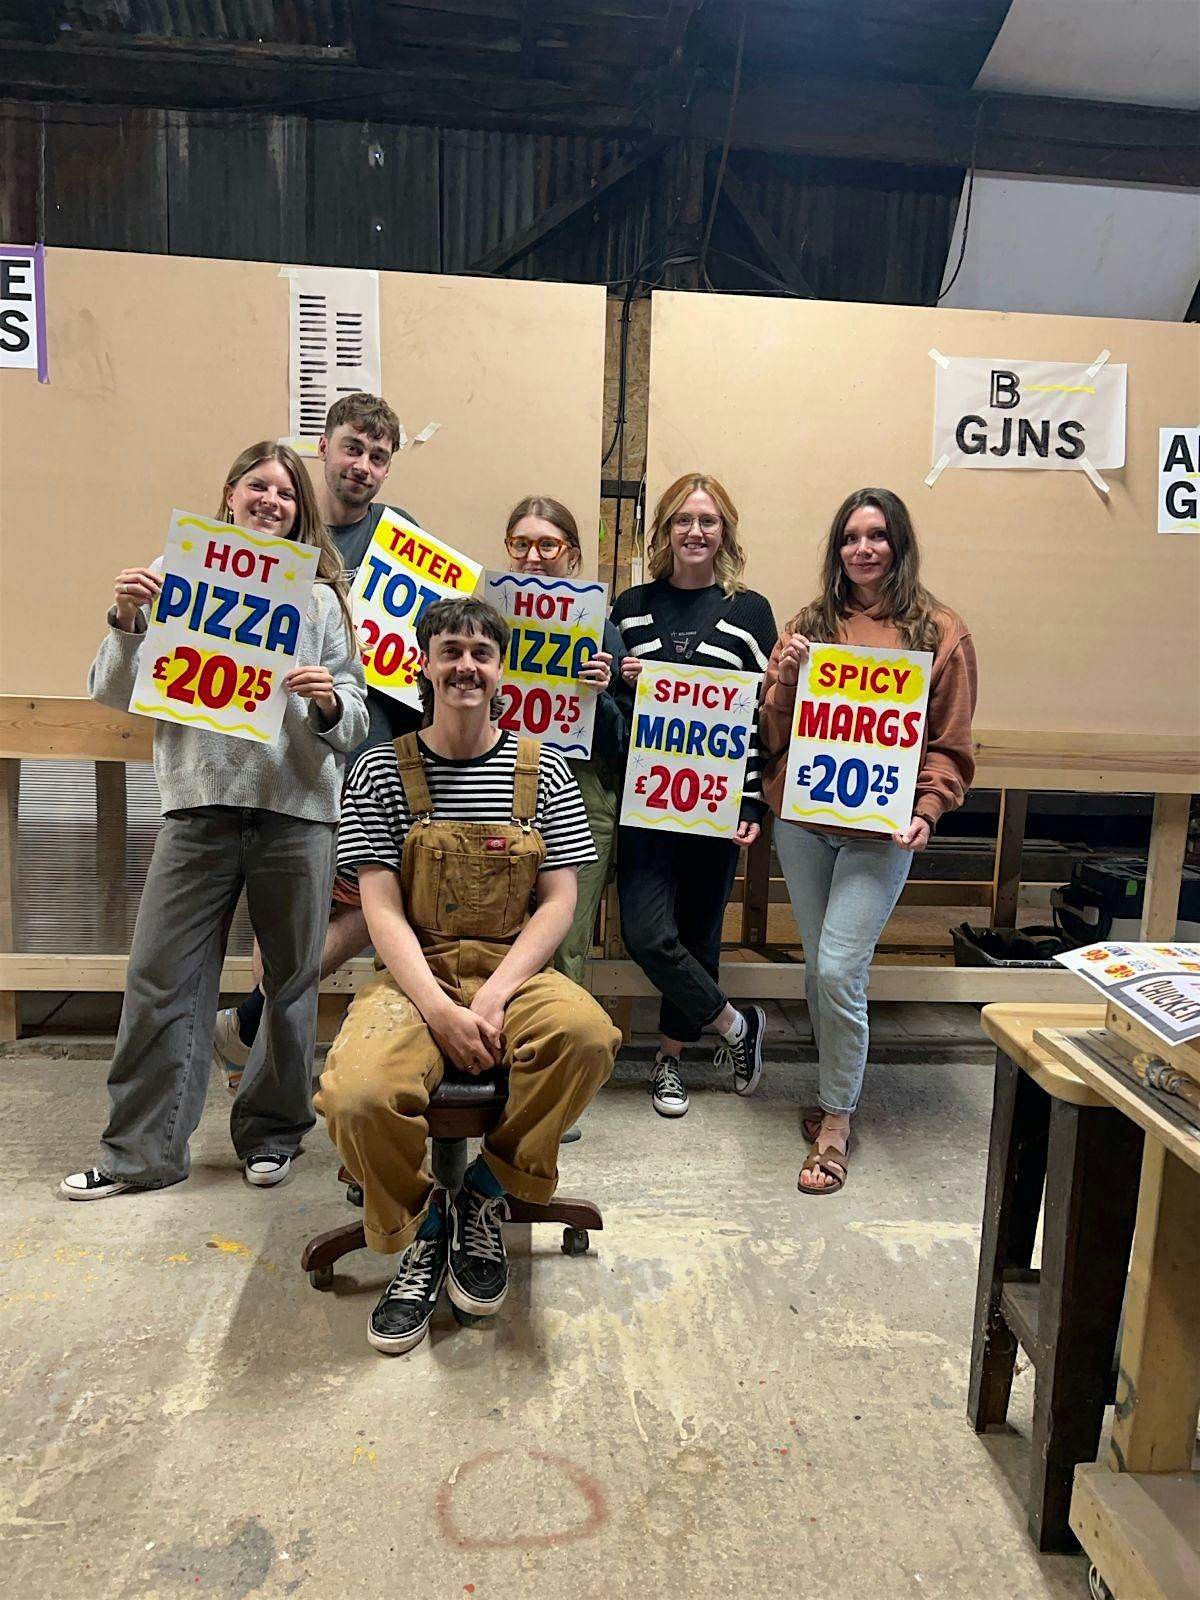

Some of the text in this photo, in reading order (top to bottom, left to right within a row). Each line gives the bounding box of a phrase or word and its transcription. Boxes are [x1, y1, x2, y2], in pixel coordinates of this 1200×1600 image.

[990, 369, 1021, 409] B
[955, 414, 1086, 460] GJNS
[1163, 434, 1200, 473] A
[204, 540, 280, 583] HOT
[388, 526, 463, 589] TATER
[155, 572, 301, 656] PIZZA
[513, 591, 575, 622] HOT
[654, 678, 739, 712] SPICY
[818, 661, 912, 696] SPICY
[635, 713, 748, 761] MARGS
[797, 700, 922, 749] MARGS
